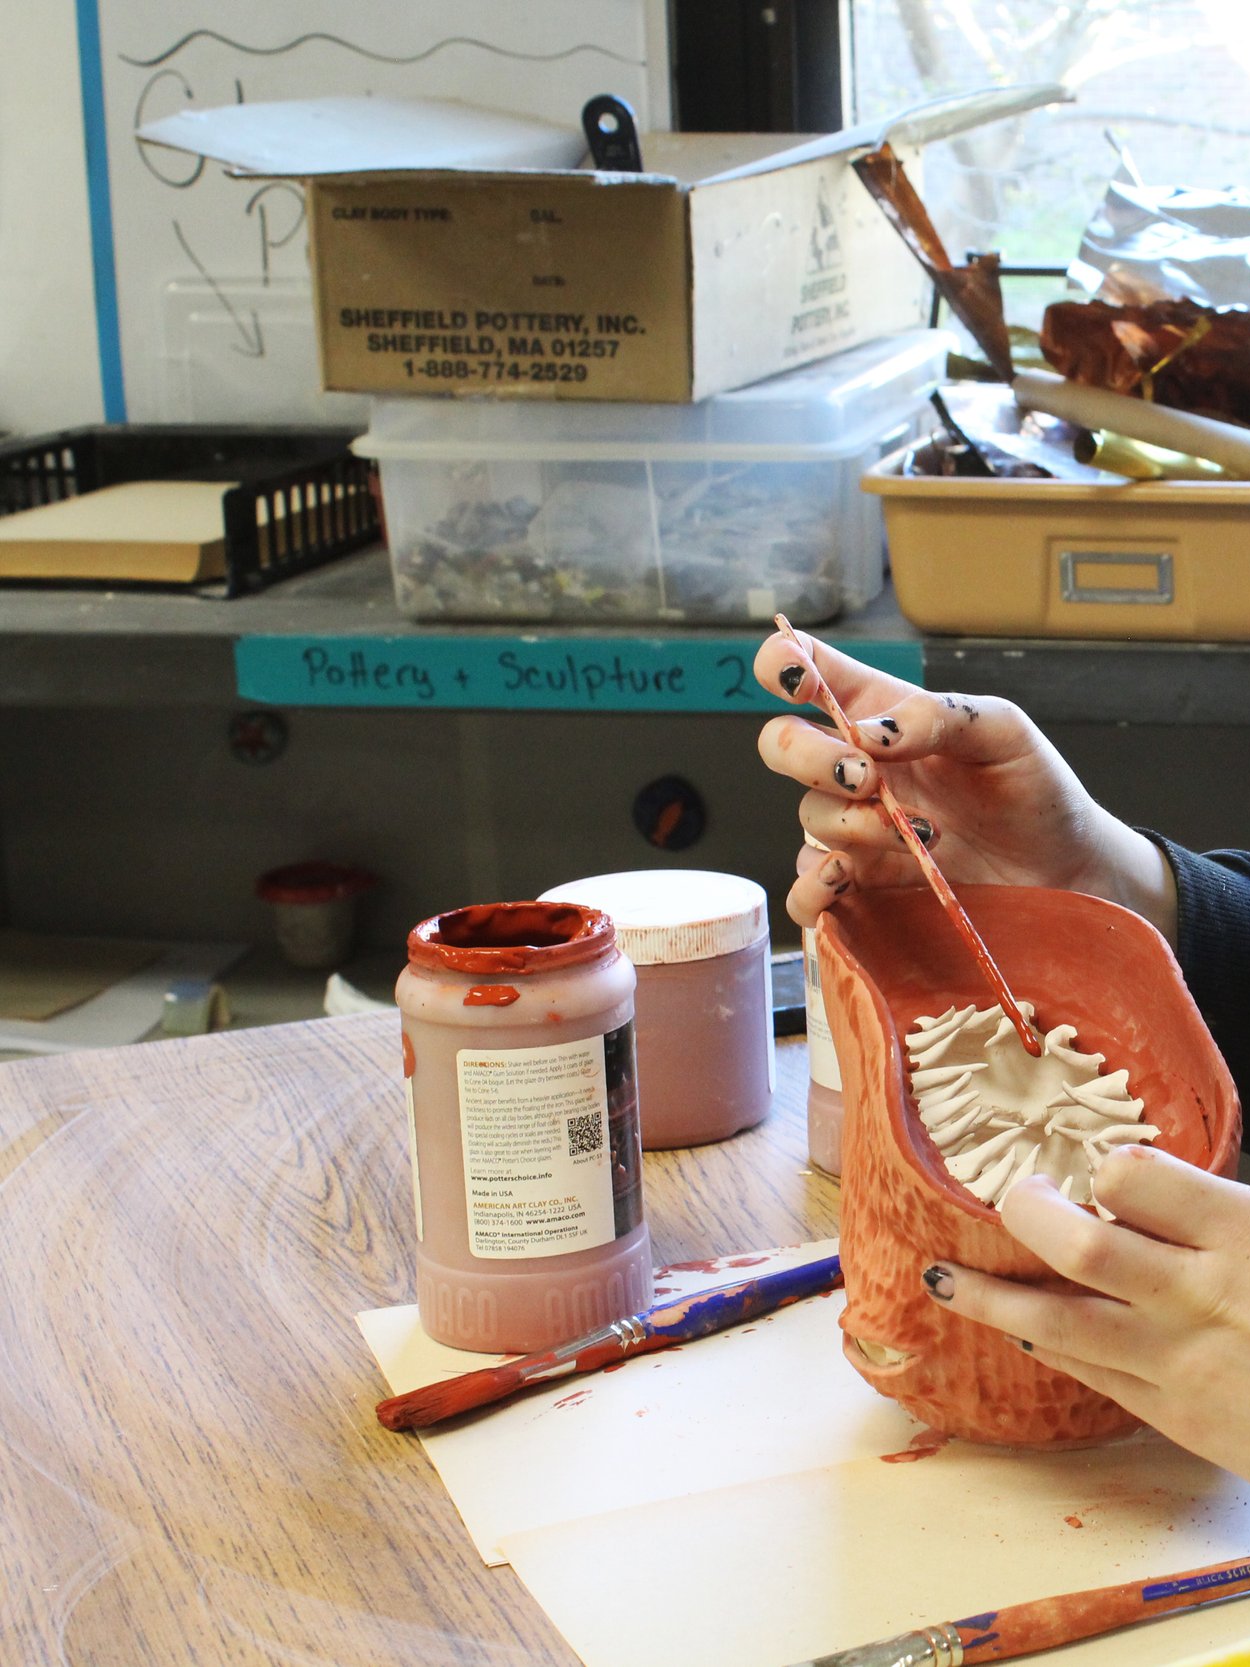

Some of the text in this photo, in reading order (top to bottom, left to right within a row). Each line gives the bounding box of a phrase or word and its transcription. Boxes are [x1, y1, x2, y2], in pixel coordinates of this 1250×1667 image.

[339, 308, 646, 336] SHEFFIELD POTTERY, INC.
[367, 334, 620, 359] SHEFFIELD, MA 01257
[403, 360, 588, 382] 1-888-774-2529
[302, 646, 753, 700] Pottery + Sculpture 2
[573, 1156, 588, 1165] About
[470, 1167, 487, 1175] Learn
[471, 1172, 553, 1182] www.potterschoice.info
[472, 1189, 490, 1197] Made
[528, 1200, 547, 1209] CLAY
[564, 1195, 579, 1204] INC.
[473, 1210, 514, 1219] Indianapolis,
[525, 1206, 565, 1217] 46254-1222
[567, 1203, 582, 1212] USA
[526, 1211, 586, 1225] www.amaco.com
[475, 1237, 506, 1245] Darlington,
[507, 1236, 529, 1245] County
[530, 1235, 555, 1243] Durham
[579, 1229, 588, 1237] UK
[501, 1230, 543, 1238] International
[544, 1225, 579, 1236] Operations
[503, 1244, 526, 1252] 194076
